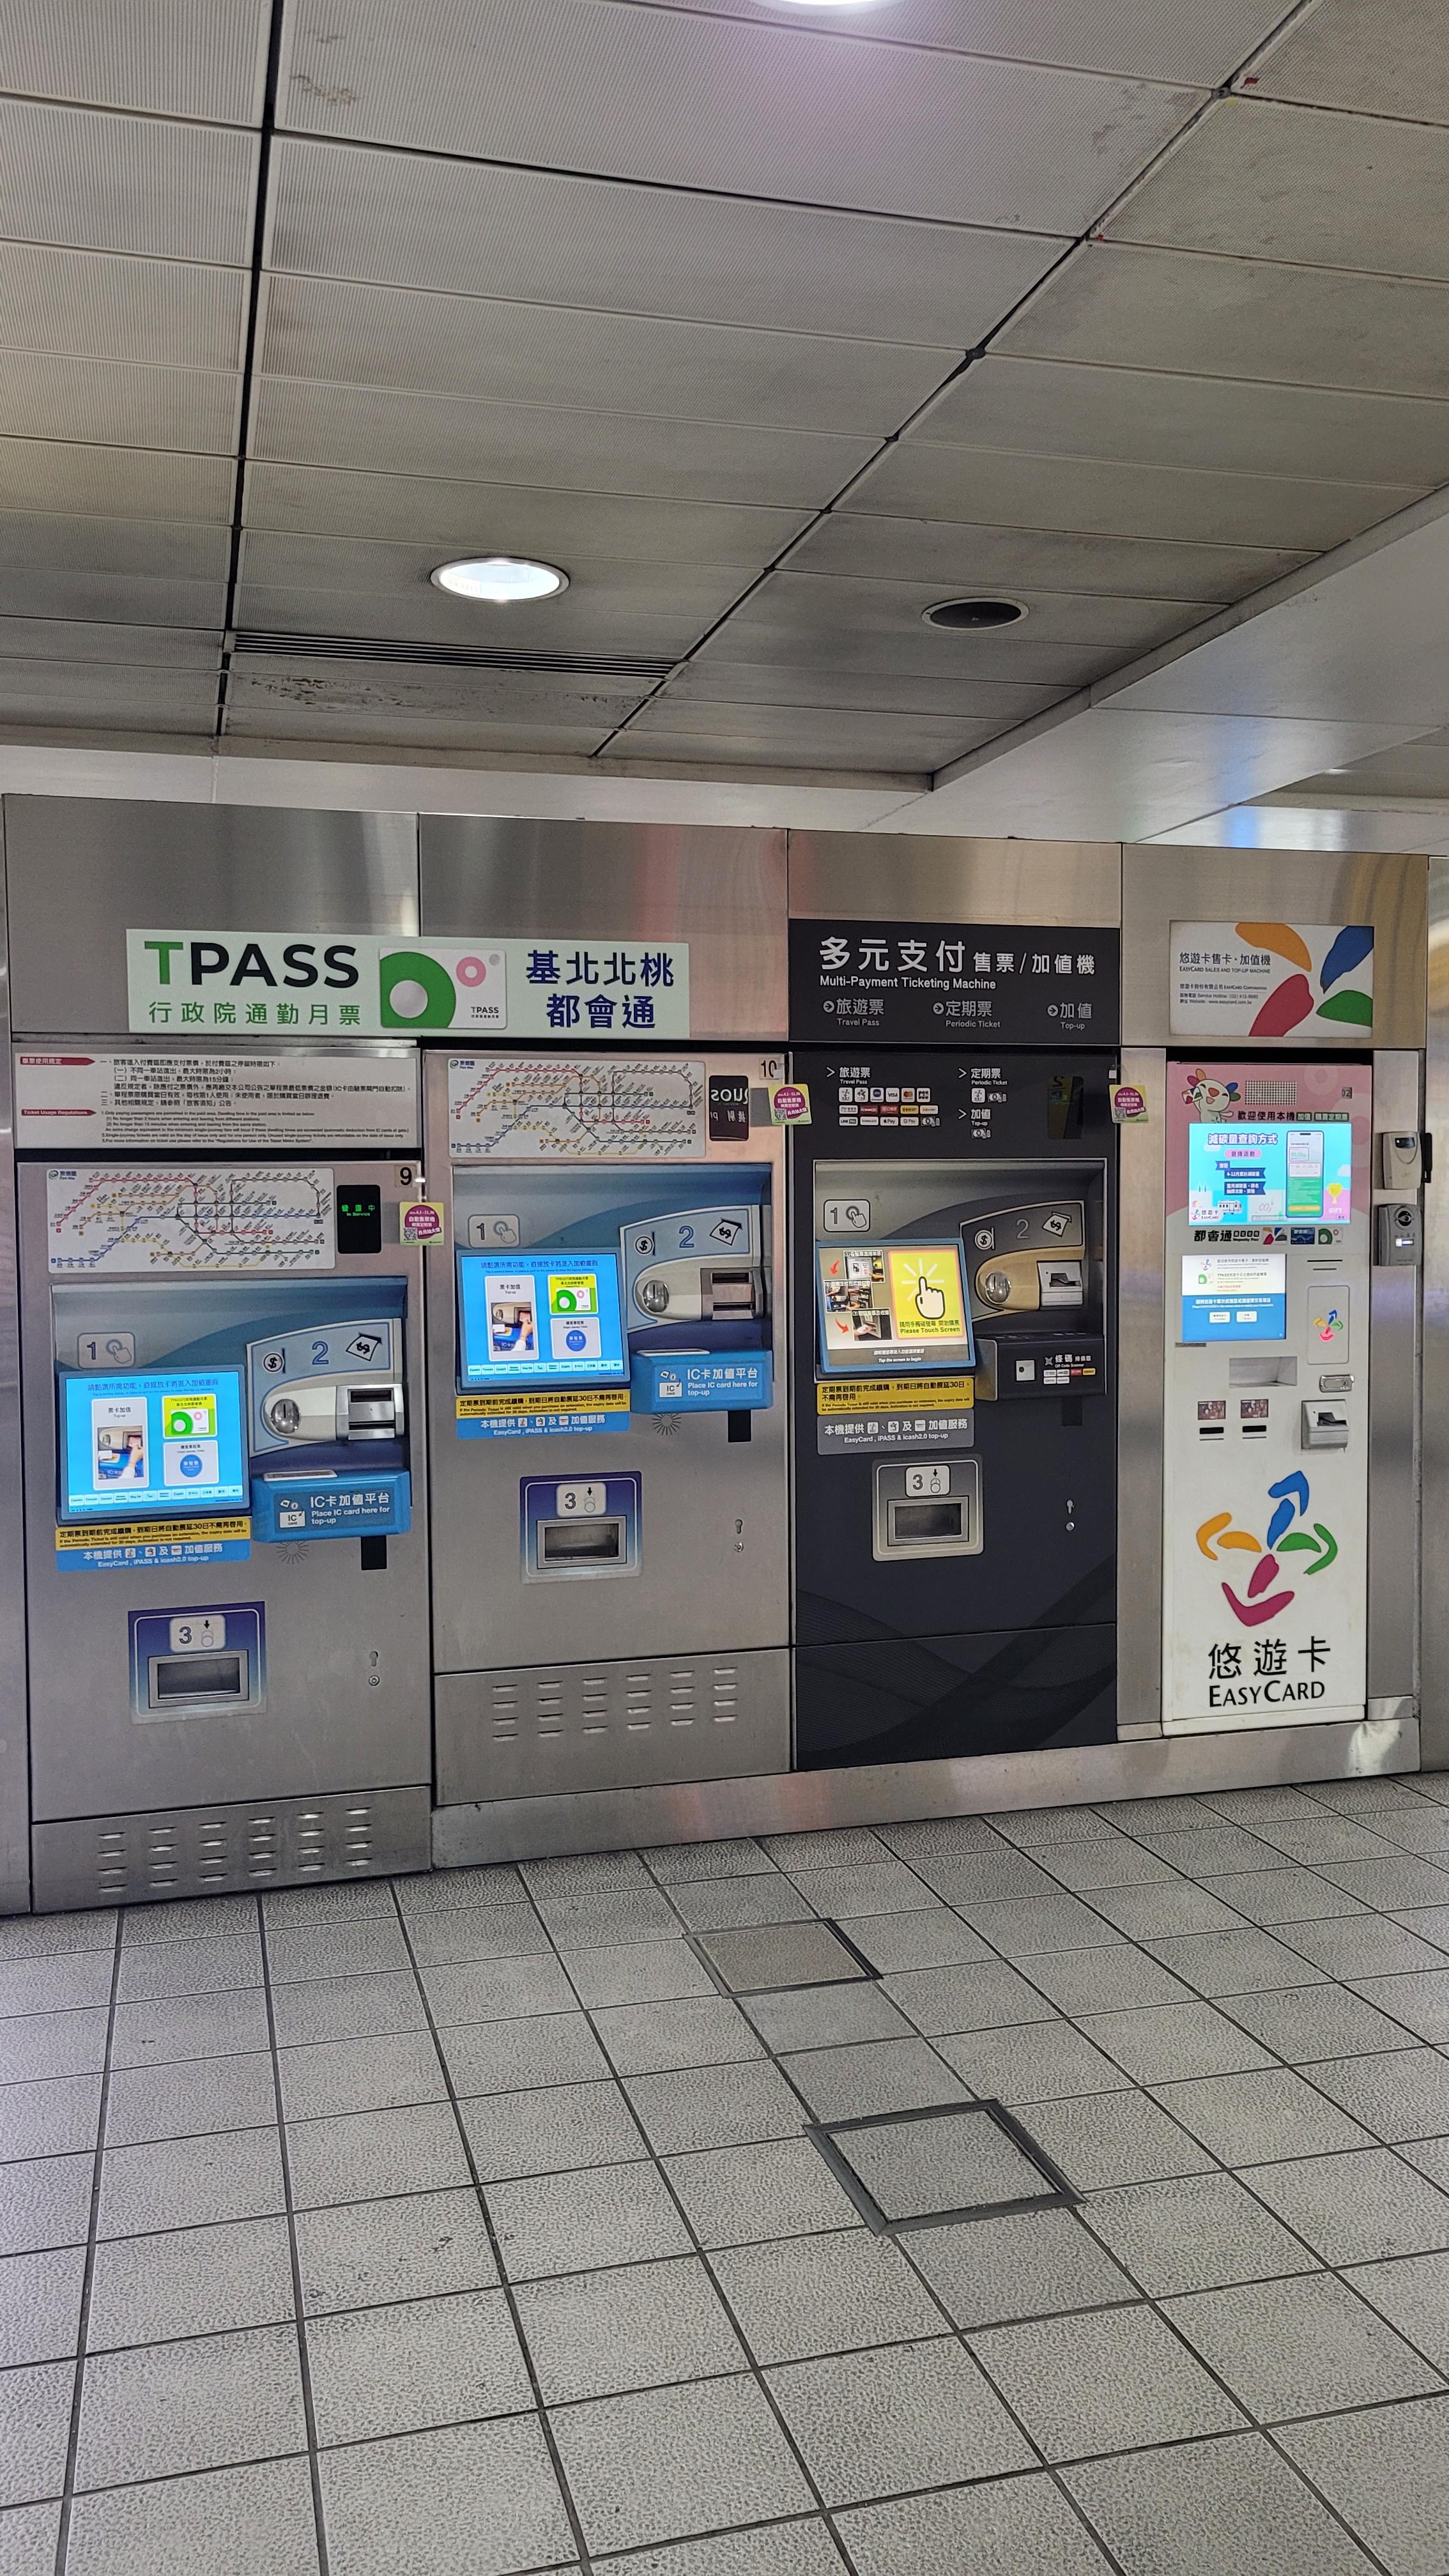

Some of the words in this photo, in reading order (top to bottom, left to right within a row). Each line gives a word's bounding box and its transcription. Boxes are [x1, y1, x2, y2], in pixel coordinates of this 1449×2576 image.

[820, 936, 965, 972] 多元支付
[144, 940, 359, 988] TPASS
[526, 949, 674, 988] 基北北桃
[820, 976, 898, 989] Multi-Payment
[901, 977, 950, 990] Ticketing
[953, 978, 997, 989] Machine
[149, 1001, 360, 1025] 行政院通勤月票
[546, 993, 656, 1029] 都會通
[836, 998, 885, 1016] 旅遊票
[946, 1000, 992, 1017] 定期票
[1059, 1002, 1092, 1020] 加值
[1061, 1022, 1085, 1031] Top-up
[761, 1060, 777, 1078] 10
[839, 1067, 870, 1078] 旅遊票
[971, 1068, 1000, 1078] 定期票
[971, 1108, 990, 1119] 加值
[1238, 1111, 1295, 1121] 歡迎使用本機
[400, 1167, 412, 1185] 9
[830, 1207, 838, 1224] 1
[477, 1223, 486, 1240] 1
[679, 1226, 694, 1248] 2
[1016, 1219, 1029, 1239] 2
[1194, 1230, 1232, 1241] 都會通
[87, 1342, 96, 1360] 1
[312, 1341, 329, 1365] 2
[687, 1368, 758, 1380] IC卡加值平台
[480, 1419, 516, 1429] 本機提供
[548, 1417, 557, 1425] 及
[571, 1414, 605, 1424] 加值服務
[824, 1423, 864, 1435] 本機提供
[902, 1421, 912, 1431] 及
[928, 1418, 967, 1430] 加值服務
[912, 1474, 923, 1490] 3
[310, 1492, 390, 1509] IC卡加值平台
[564, 1492, 576, 1509] 3
[312, 1517, 337, 1525] top-up
[83, 1549, 122, 1561] 本機提供
[159, 1546, 169, 1555] 及
[185, 1543, 223, 1554] 加值服務
[179, 1626, 192, 1644] 3
[1208, 1636, 1331, 1680] 悠遊卡
